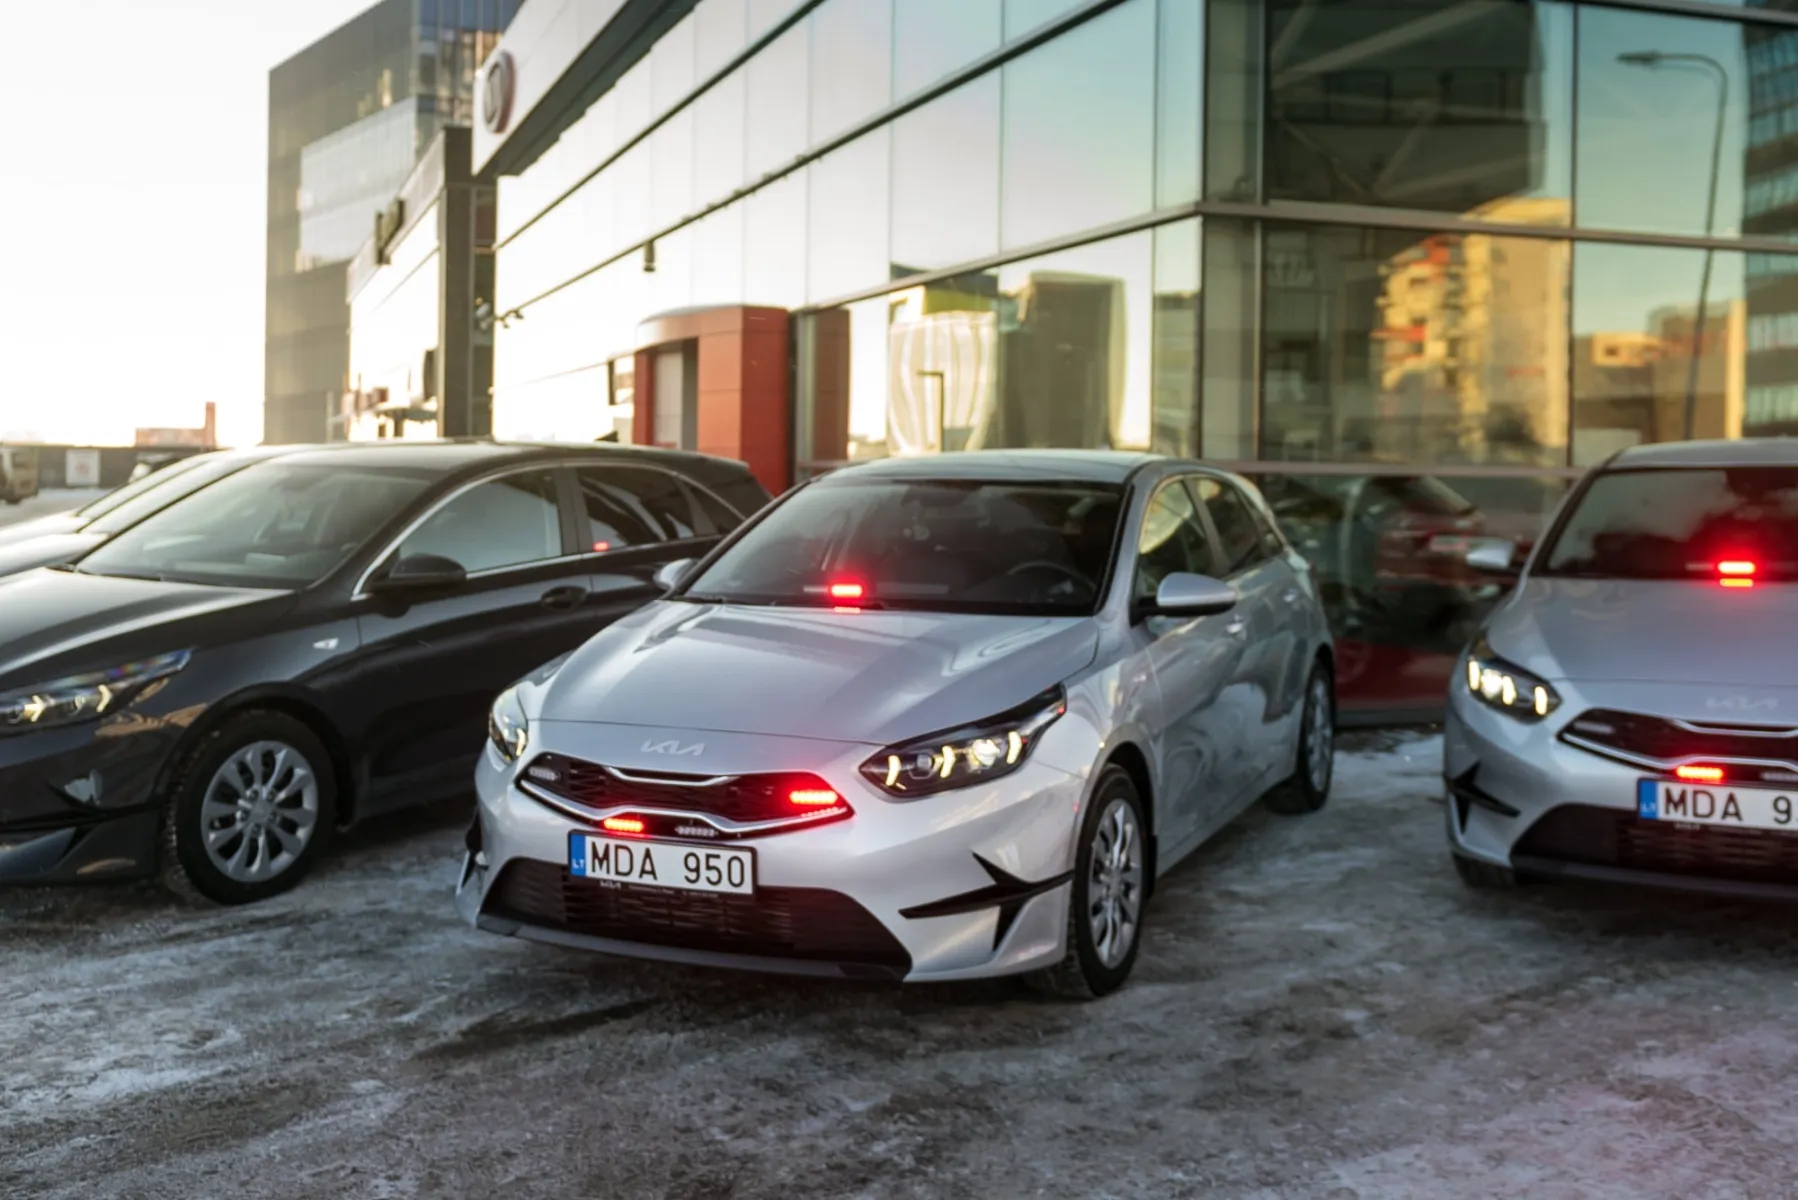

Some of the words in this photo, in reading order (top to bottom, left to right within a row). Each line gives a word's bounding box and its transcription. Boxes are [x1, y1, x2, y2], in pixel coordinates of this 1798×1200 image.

[640, 738, 706, 756] KIA
[1665, 788, 1743, 821] MDA
[572, 858, 586, 869] LT
[591, 841, 658, 881] MDA
[684, 852, 745, 888] 950
